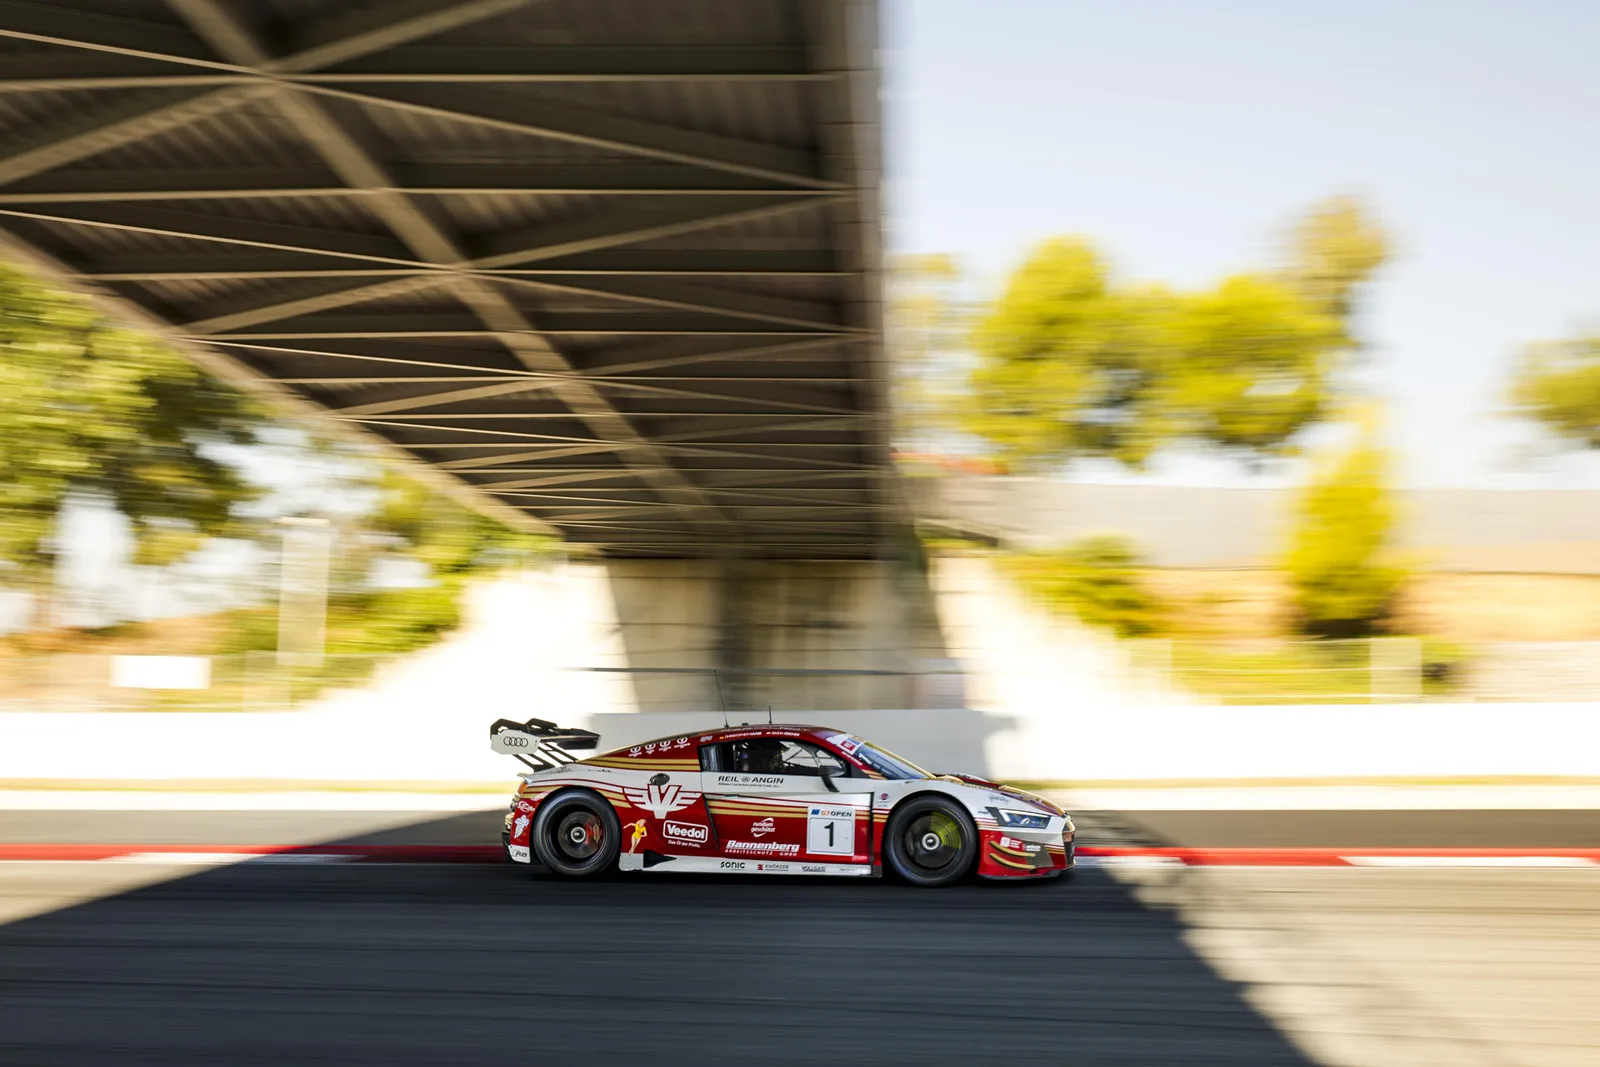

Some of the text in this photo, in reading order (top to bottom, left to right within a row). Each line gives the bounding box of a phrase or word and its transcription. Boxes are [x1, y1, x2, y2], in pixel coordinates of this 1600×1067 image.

[752, 776, 784, 784] ANGIN
[667, 823, 705, 839] Veedol
[824, 821, 834, 847] 1
[725, 839, 800, 853] Bannenberg
